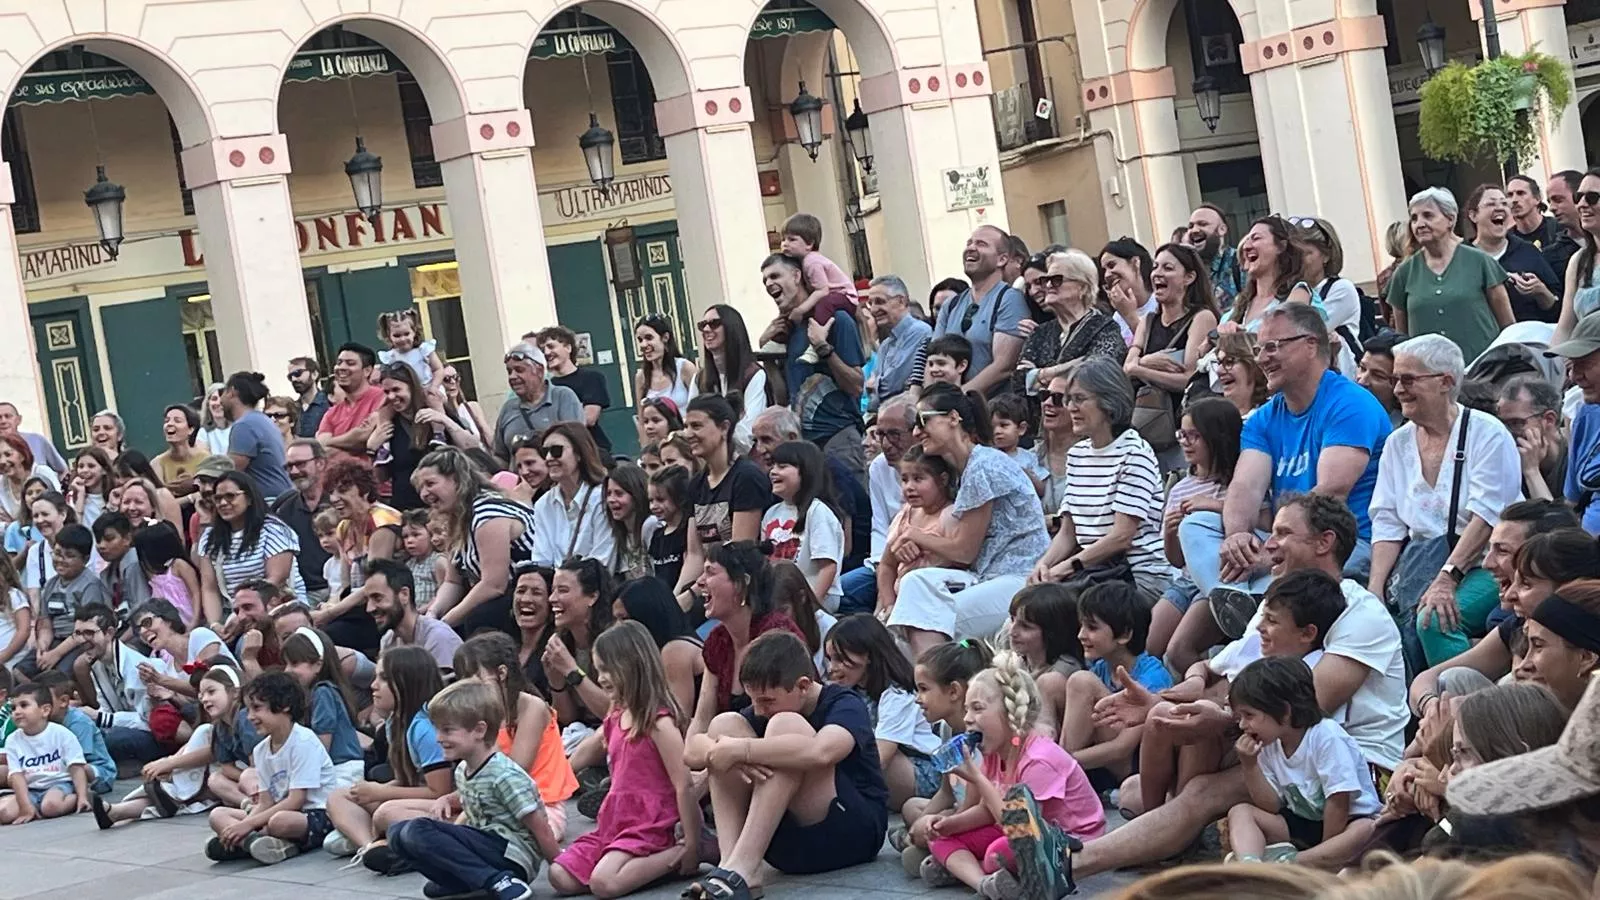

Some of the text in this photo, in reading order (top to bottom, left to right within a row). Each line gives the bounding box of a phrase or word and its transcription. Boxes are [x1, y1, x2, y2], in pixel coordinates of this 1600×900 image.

[776, 17, 796, 30] 1871
[553, 35, 567, 54] LA
[567, 33, 616, 52] CONFIANZA
[320, 56, 335, 76] LA
[335, 54, 389, 75] CONFIANZA
[34, 83, 56, 96] sus
[60, 73, 144, 98] especialidad
[557, 175, 672, 218] ULTRAMARINOS
[178, 203, 445, 267] L ONFIAN
[21, 243, 114, 280] AMARINOS
